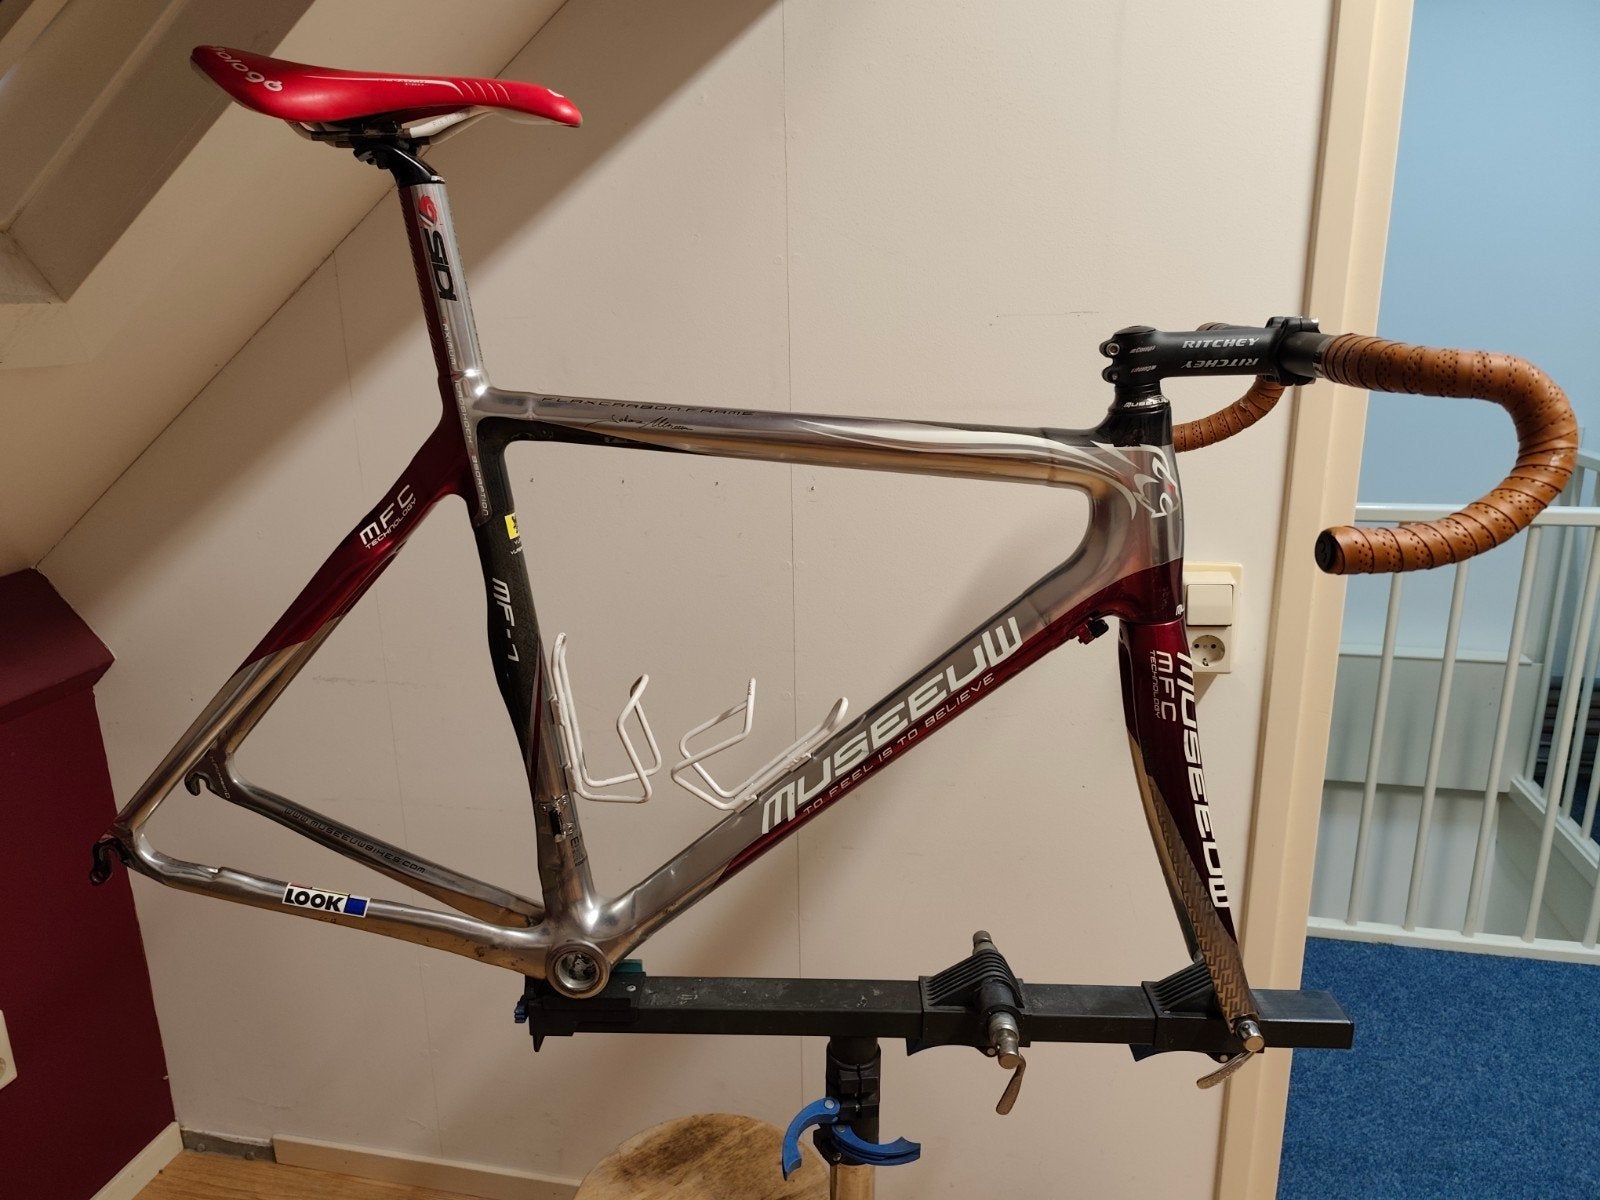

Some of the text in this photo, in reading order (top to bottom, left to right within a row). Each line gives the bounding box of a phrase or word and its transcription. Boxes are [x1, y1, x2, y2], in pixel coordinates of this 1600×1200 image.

[1180, 357, 1260, 369] RITCHEY
[1181, 337, 1261, 349] RITCHEY
[358, 484, 415, 546] MFC
[364, 497, 417, 550] TECHNOLOGY
[1149, 650, 1161, 719] TECHNOLOGY
[1156, 650, 1177, 722] MFC
[761, 616, 1024, 835] MUSEEUW
[803, 672, 995, 816] TO FEEL IS TO BELIEVE
[1176, 651, 1230, 908] MUSEEUW
[283, 888, 345, 912] LOOK
